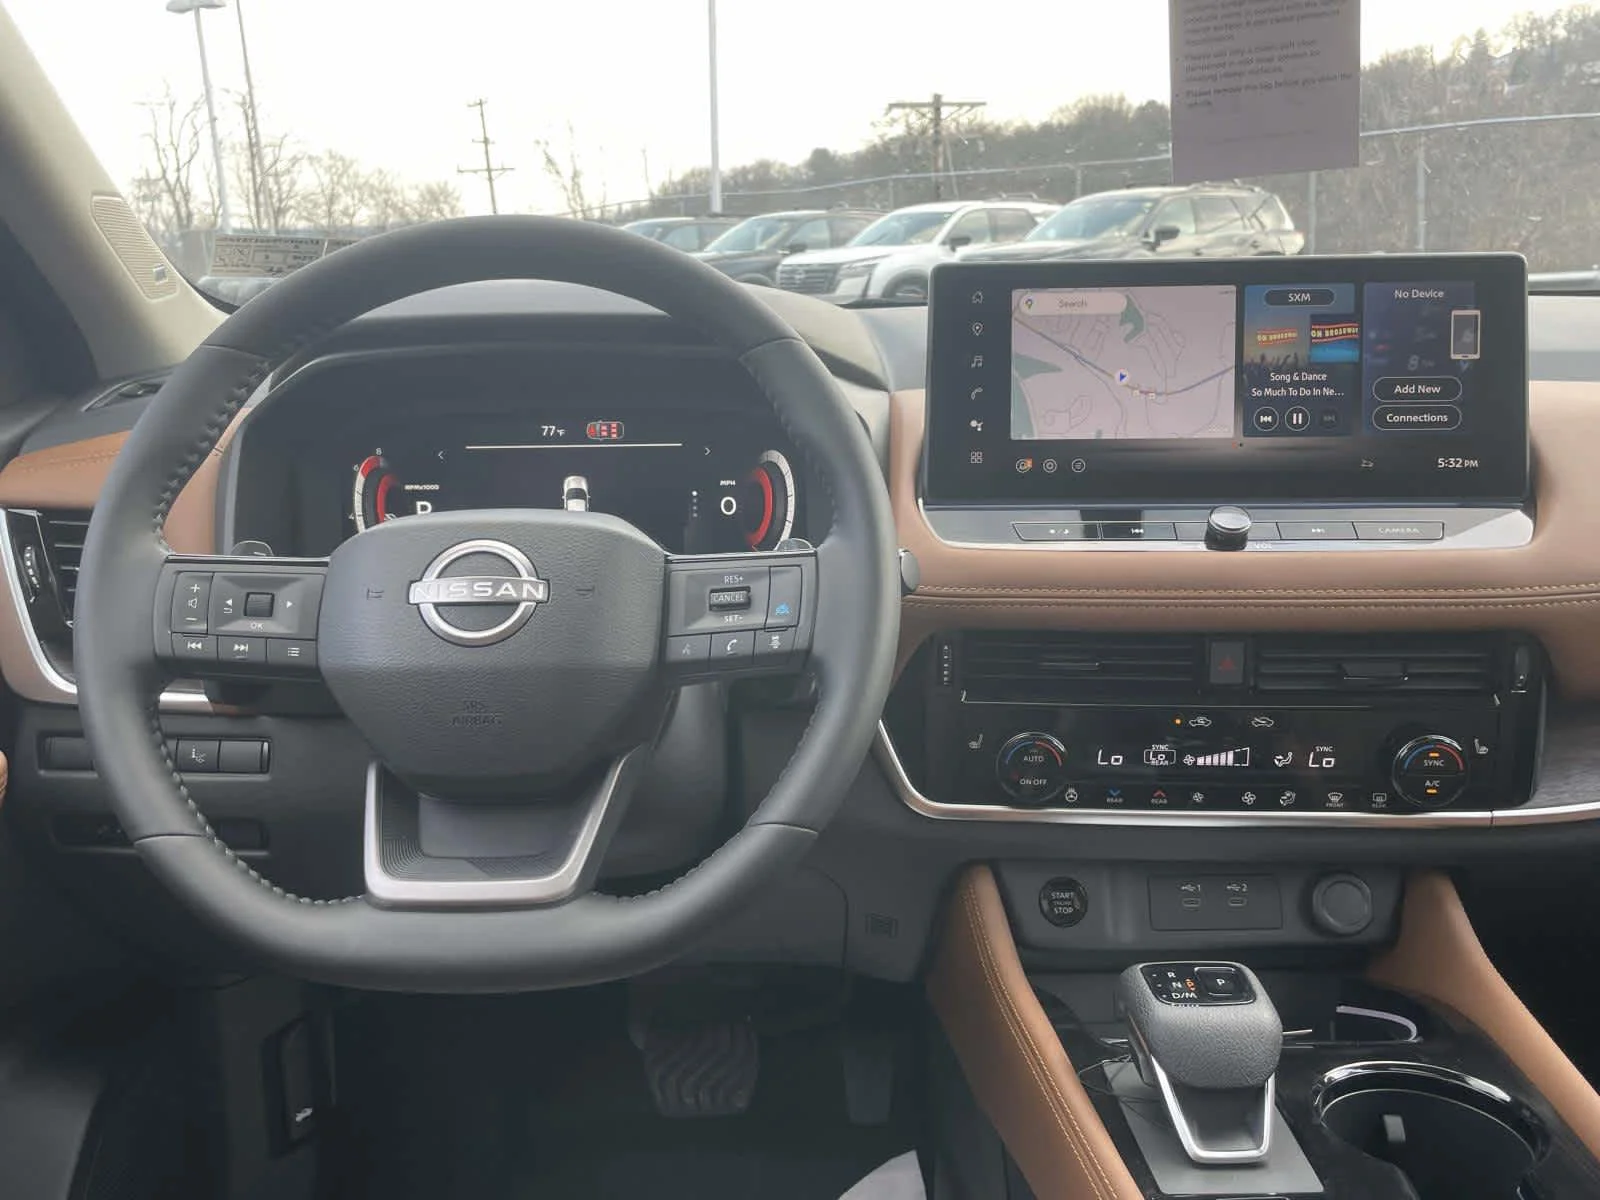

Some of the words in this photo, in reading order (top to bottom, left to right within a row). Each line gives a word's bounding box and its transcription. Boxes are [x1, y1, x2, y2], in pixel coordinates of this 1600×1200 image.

[1288, 292, 1311, 302] SXM
[1394, 289, 1409, 298] No
[1411, 289, 1444, 298] Device
[1058, 298, 1088, 308] Search
[1311, 330, 1322, 338] ON
[1324, 326, 1359, 337] BROADWAY
[1270, 372, 1290, 383] Song
[1292, 372, 1299, 381] &
[1301, 372, 1327, 381] Dance
[1251, 387, 1262, 397] So
[1264, 387, 1286, 396] Much
[1288, 387, 1298, 396] To
[1299, 387, 1311, 396] Do
[1313, 387, 1321, 396] In
[1394, 384, 1415, 394] Add
[1418, 384, 1441, 394] New
[1386, 413, 1449, 422] Connections
[541, 425, 556, 436] 77
[1438, 457, 1463, 468] 5:32
[1464, 459, 1479, 467] PM
[724, 575, 744, 584] RES+
[412, 582, 545, 601] NISSAN
[711, 592, 746, 602] CANCEL
[250, 622, 264, 630] OK
[1097, 749, 1124, 765] Lo
[1308, 751, 1335, 768] Lo
[1423, 759, 1445, 767] SYNC
[1051, 891, 1074, 899] START
[1216, 978, 1225, 986] P
